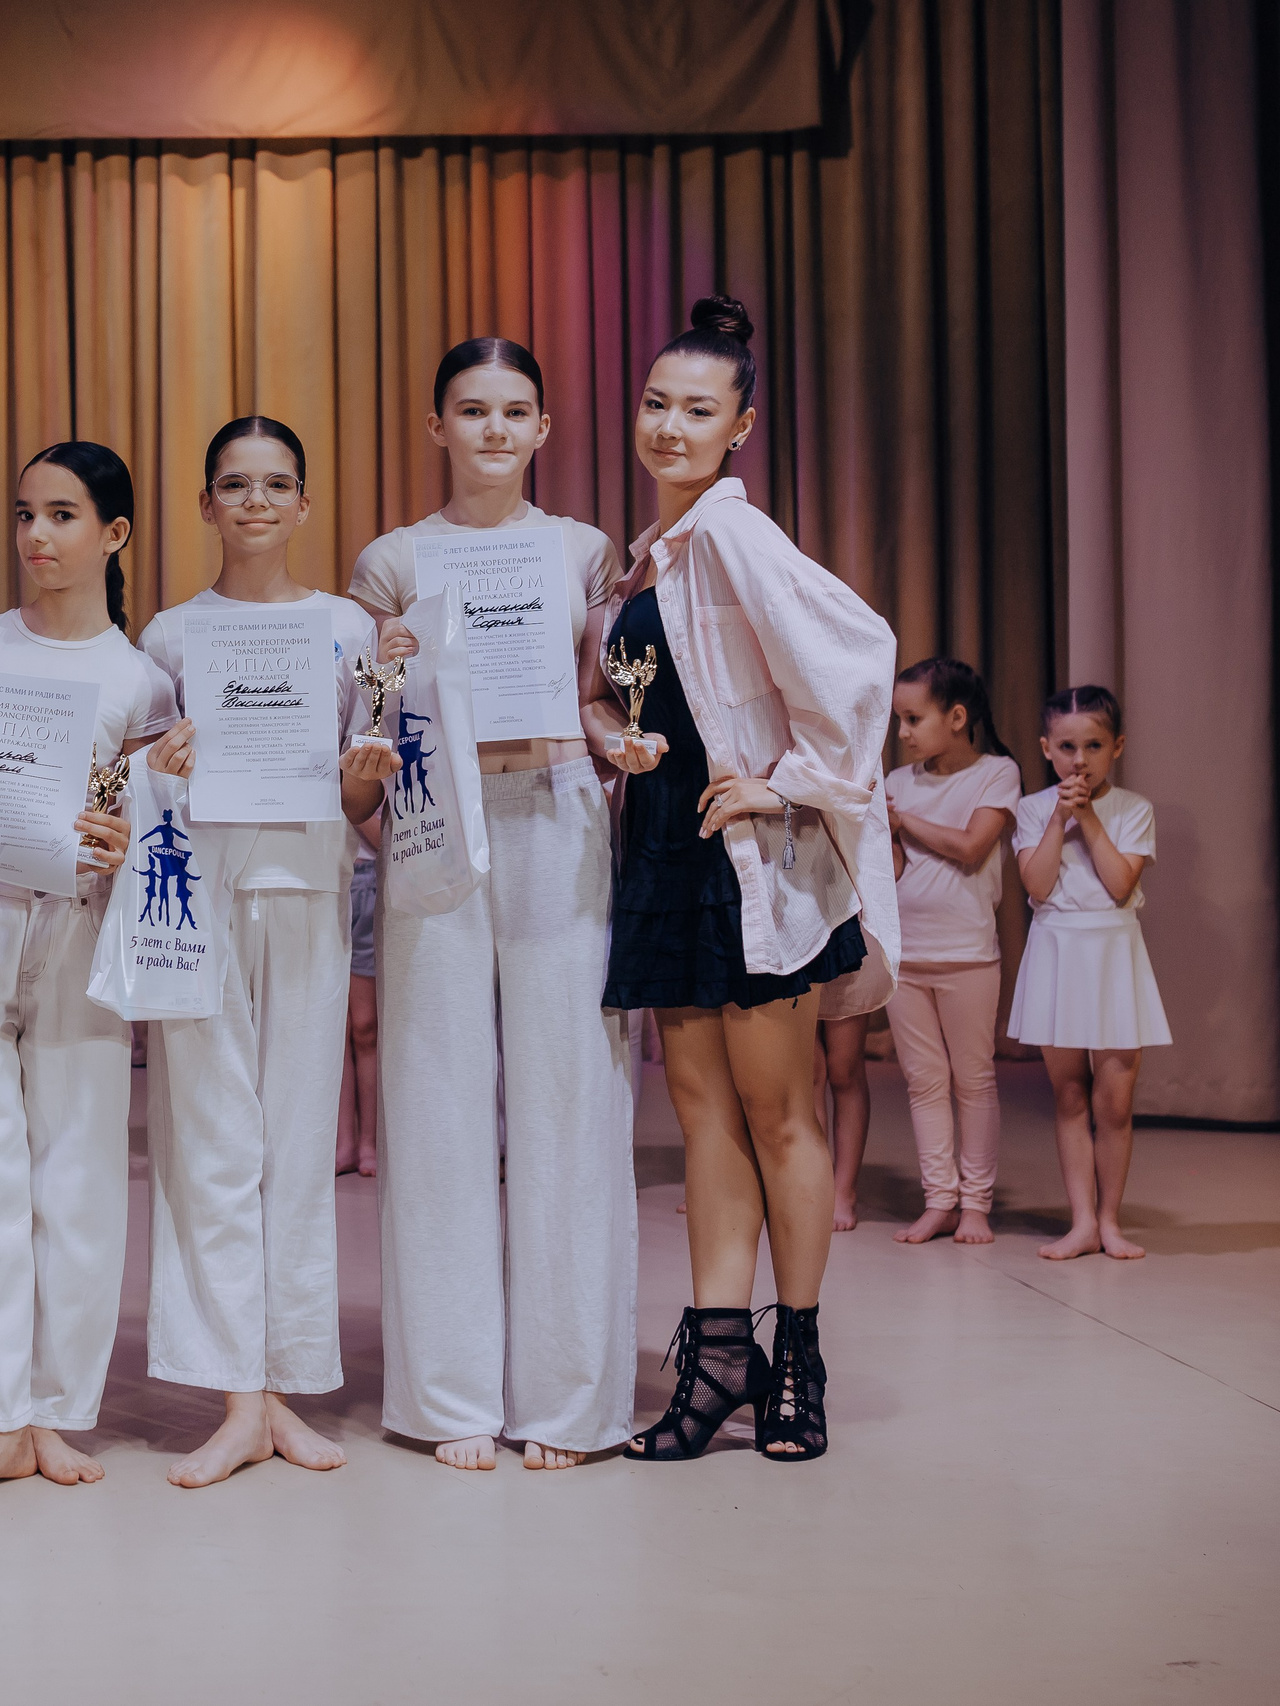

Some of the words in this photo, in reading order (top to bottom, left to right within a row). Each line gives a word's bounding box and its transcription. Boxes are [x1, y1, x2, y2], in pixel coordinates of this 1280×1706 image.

[443, 561, 477, 569] СТУДИЯ
[481, 556, 541, 566] ХОРЕОГРАФИИ
[472, 592, 522, 600] НАГРАЖДАЕТСЯ
[470, 612, 523, 631] София
[249, 638, 310, 646] ХОРЕОГРАФИИ
[206, 657, 311, 673] ДИПЛОМ
[5, 686, 26, 694] ВАМИ
[35, 690, 53, 698] РАДИ
[12, 703, 73, 717] ХОРЕОГРАФИИ
[393, 829, 411, 843] лет
[414, 826, 418, 836] с
[420, 818, 444, 834] Вами
[152, 846, 185, 859] DANCEPOULL
[392, 852, 399, 862] и
[401, 842, 422, 864] ради
[425, 833, 444, 852] Вас!
[129, 935, 138, 948] 5
[141, 936, 163, 949] лет
[165, 940, 172, 950] с
[174, 938, 206, 954] Вами
[136, 954, 144, 965] и
[146, 954, 172, 970] ради
[176, 956, 200, 971] Вас!
